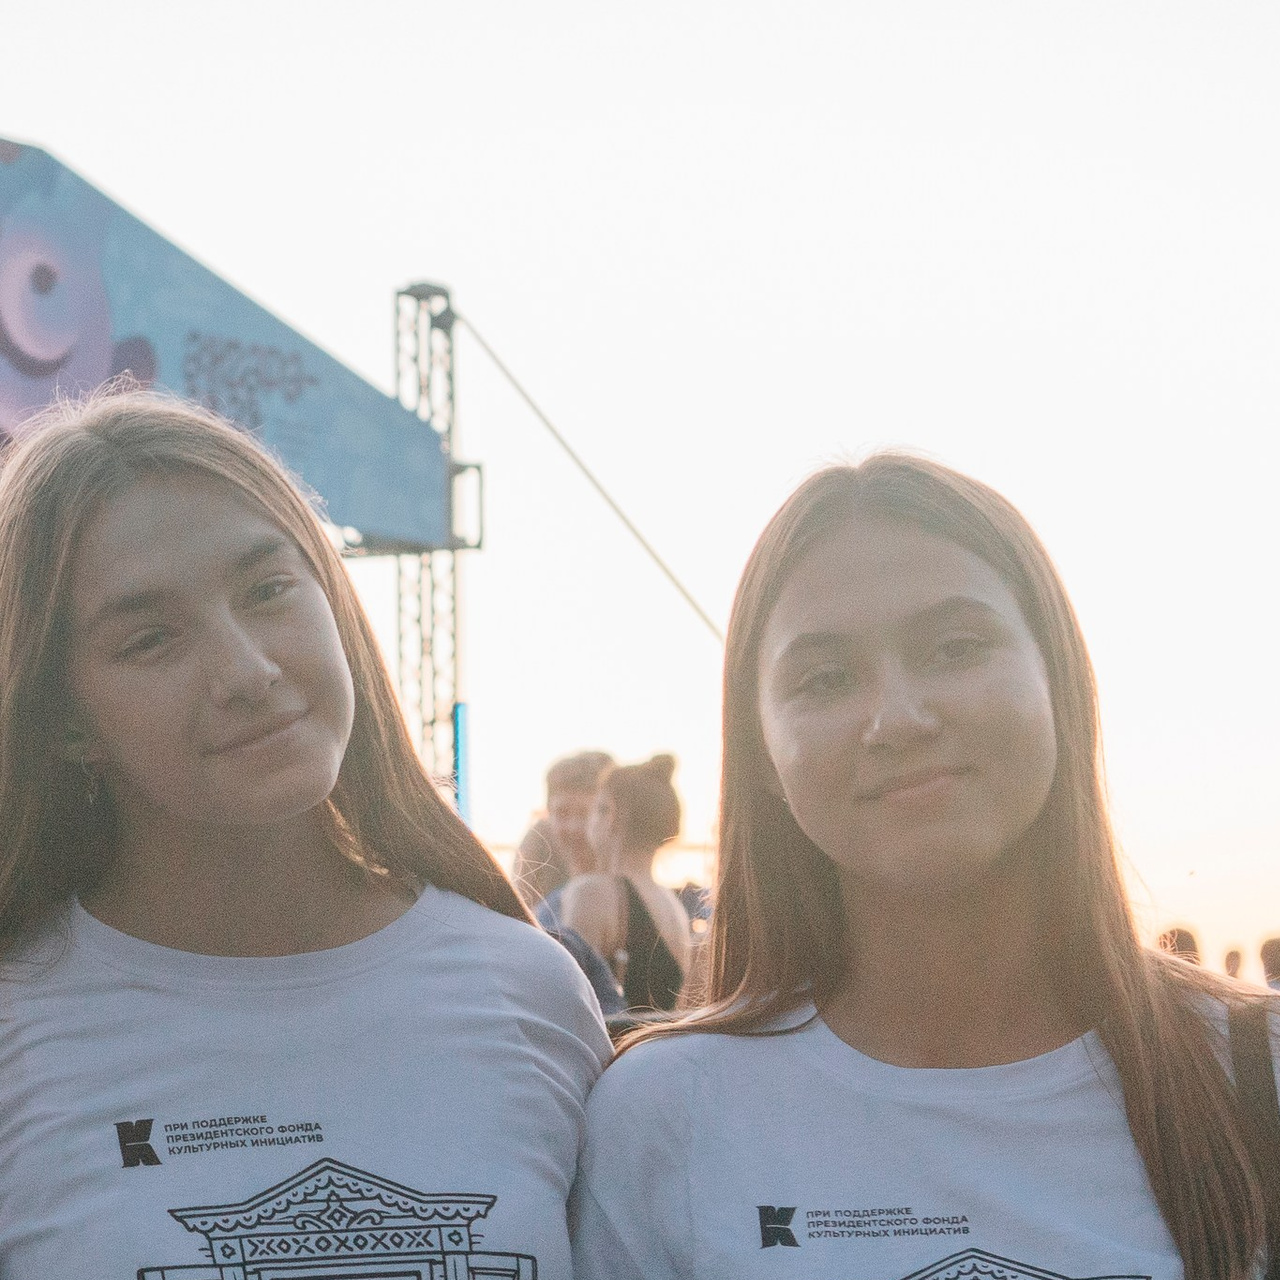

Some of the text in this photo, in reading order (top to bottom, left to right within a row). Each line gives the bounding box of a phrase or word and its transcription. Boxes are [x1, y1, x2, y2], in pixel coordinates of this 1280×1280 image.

[164, 1115, 267, 1133] ПРИ ПОДДЕРЖКЕ
[166, 1122, 322, 1143] ПРЕЗИДЕНТСКОГО ФОНДА
[167, 1134, 324, 1155] КУЛЬТУРНЫХ ИНИЦИАТИВ
[806, 1207, 913, 1219] ПРИ ПОДДЕРЖКЕ
[807, 1215, 969, 1229] ПРЕЗИДЕНТСКОГО ФОНДА
[808, 1226, 971, 1239] КУЛЬТУРНЫХ ИНИЦИАТИВ
